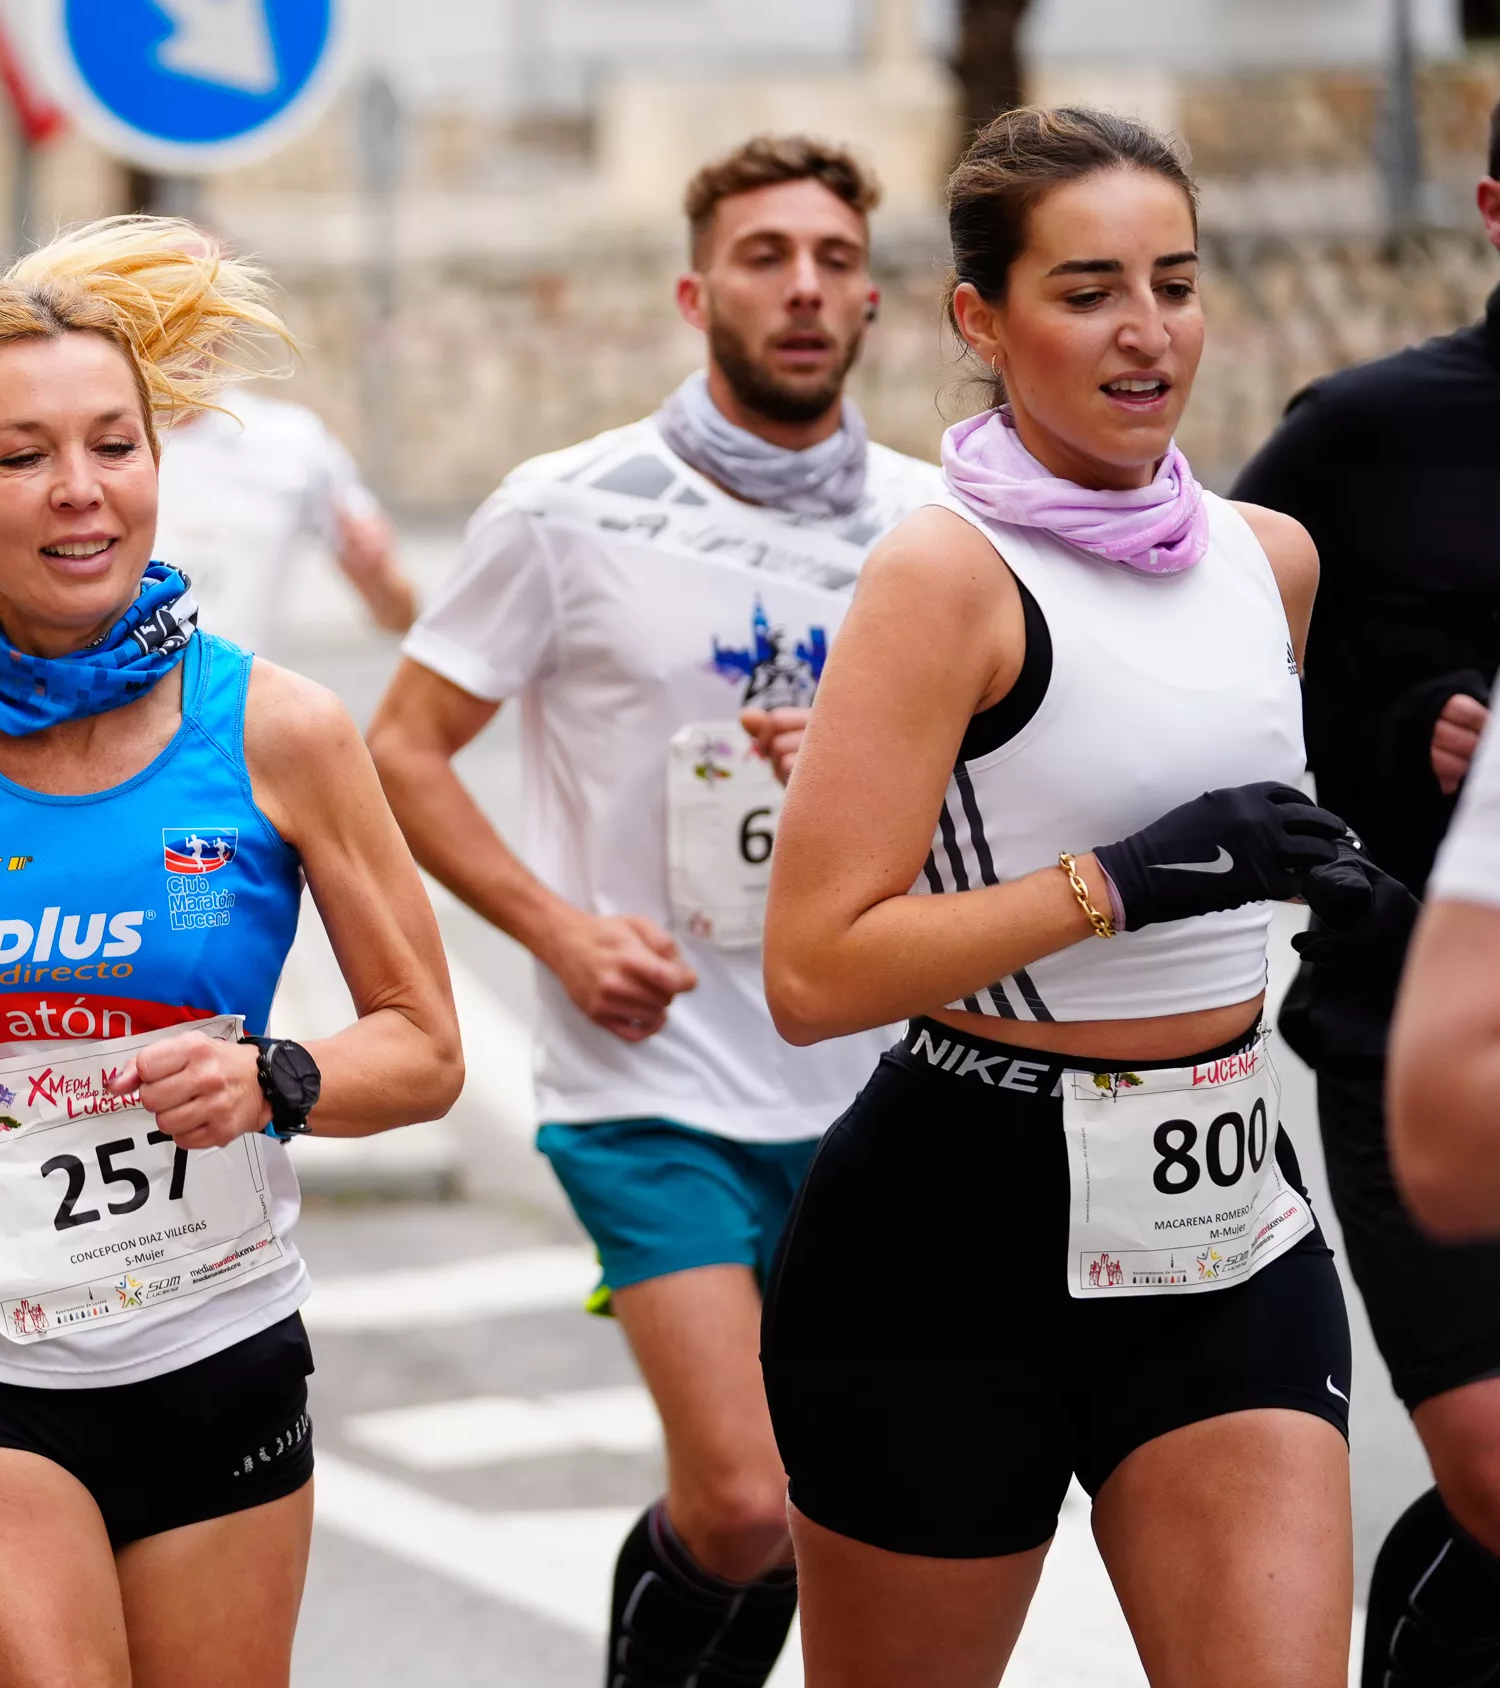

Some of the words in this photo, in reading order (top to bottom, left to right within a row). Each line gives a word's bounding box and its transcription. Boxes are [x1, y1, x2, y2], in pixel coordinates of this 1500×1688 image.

[166, 875, 209, 894] Club
[168, 889, 236, 912] Maratón
[170, 910, 231, 930] Lucena
[910, 1028, 1050, 1094] NIKE
[1192, 1050, 1259, 1087] LUCENA
[1153, 1097, 1267, 1195] 800
[40, 1130, 188, 1231] 257
[1153, 1214, 1213, 1231] MACARENA
[1215, 1204, 1250, 1223] ROMERO
[1209, 1223, 1246, 1240] M-Mujer
[70, 1239, 137, 1265] CONCEPCION
[139, 1233, 163, 1247] DIAZ
[164, 1219, 208, 1242] VILLEGAS
[124, 1249, 165, 1267] S-Mujer
[190, 1238, 269, 1277] mediamaratonlucena.com
